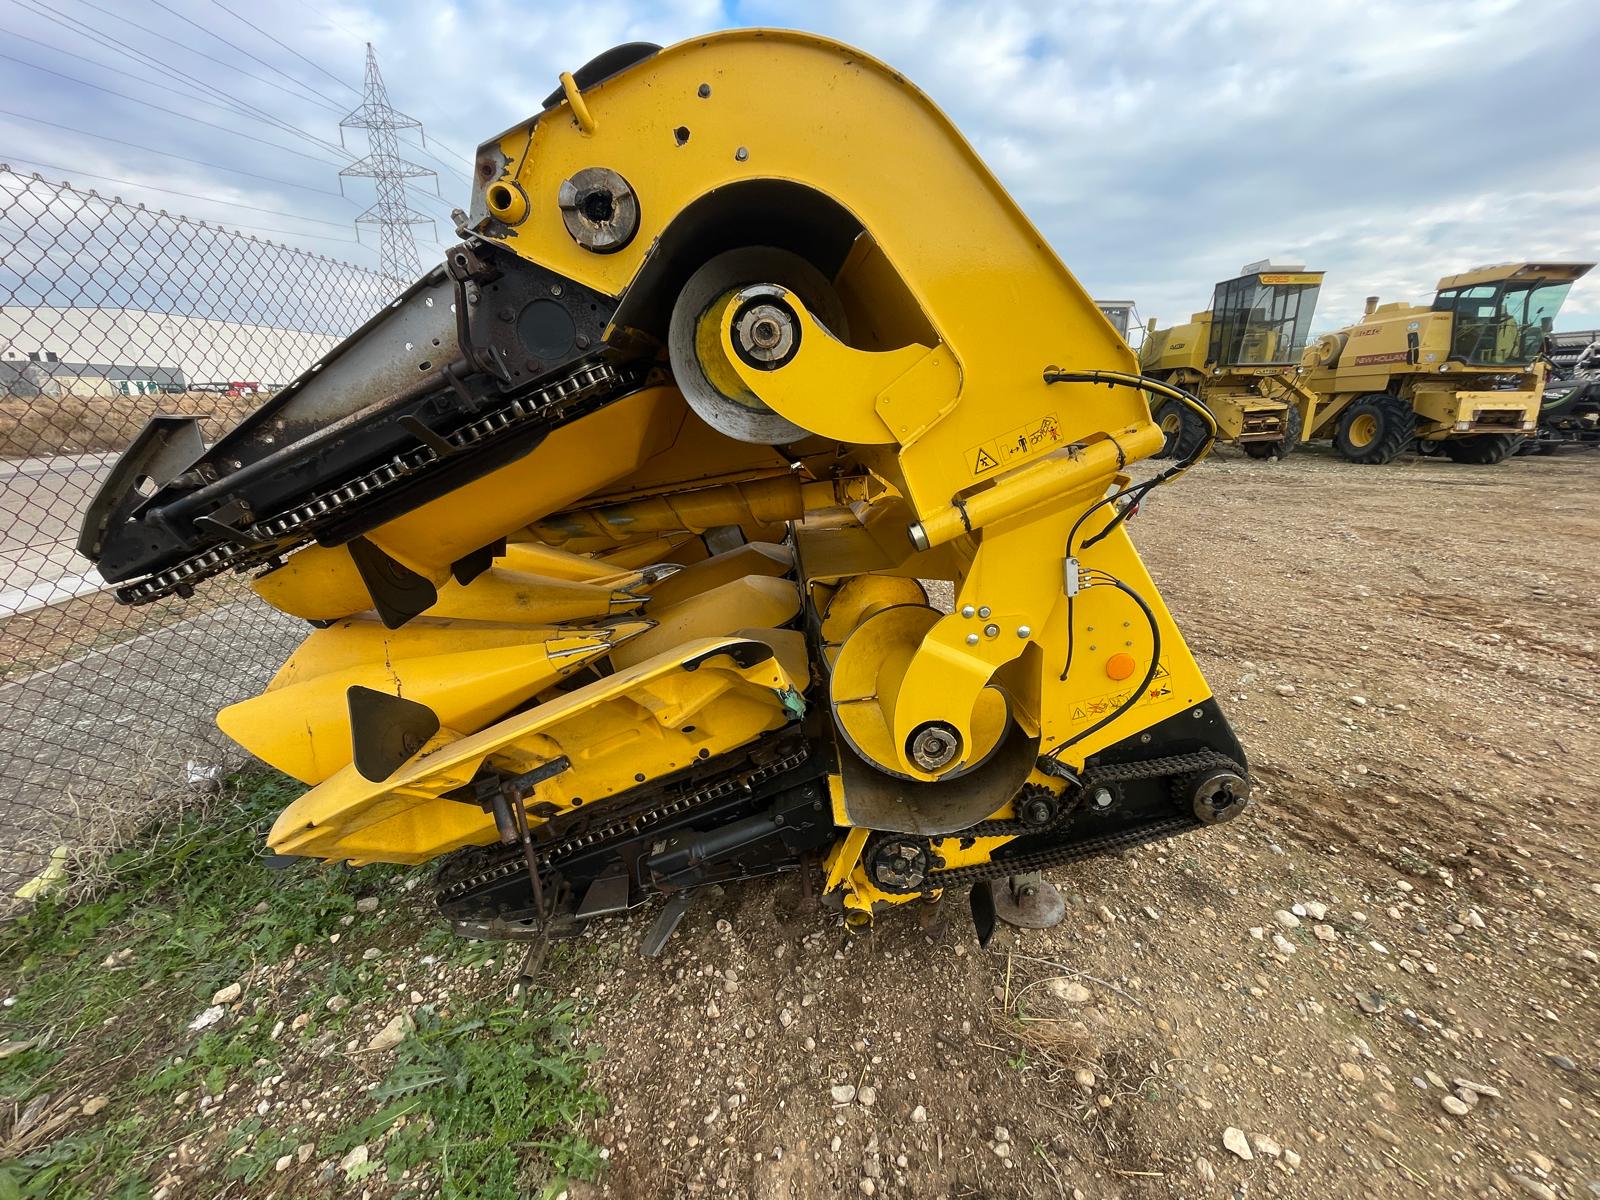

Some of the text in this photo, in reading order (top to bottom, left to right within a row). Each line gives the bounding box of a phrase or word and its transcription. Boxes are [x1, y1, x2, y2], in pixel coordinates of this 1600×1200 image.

[1262, 275, 1290, 283] CERES
[1356, 353, 1407, 364] NEW HOLLAN
